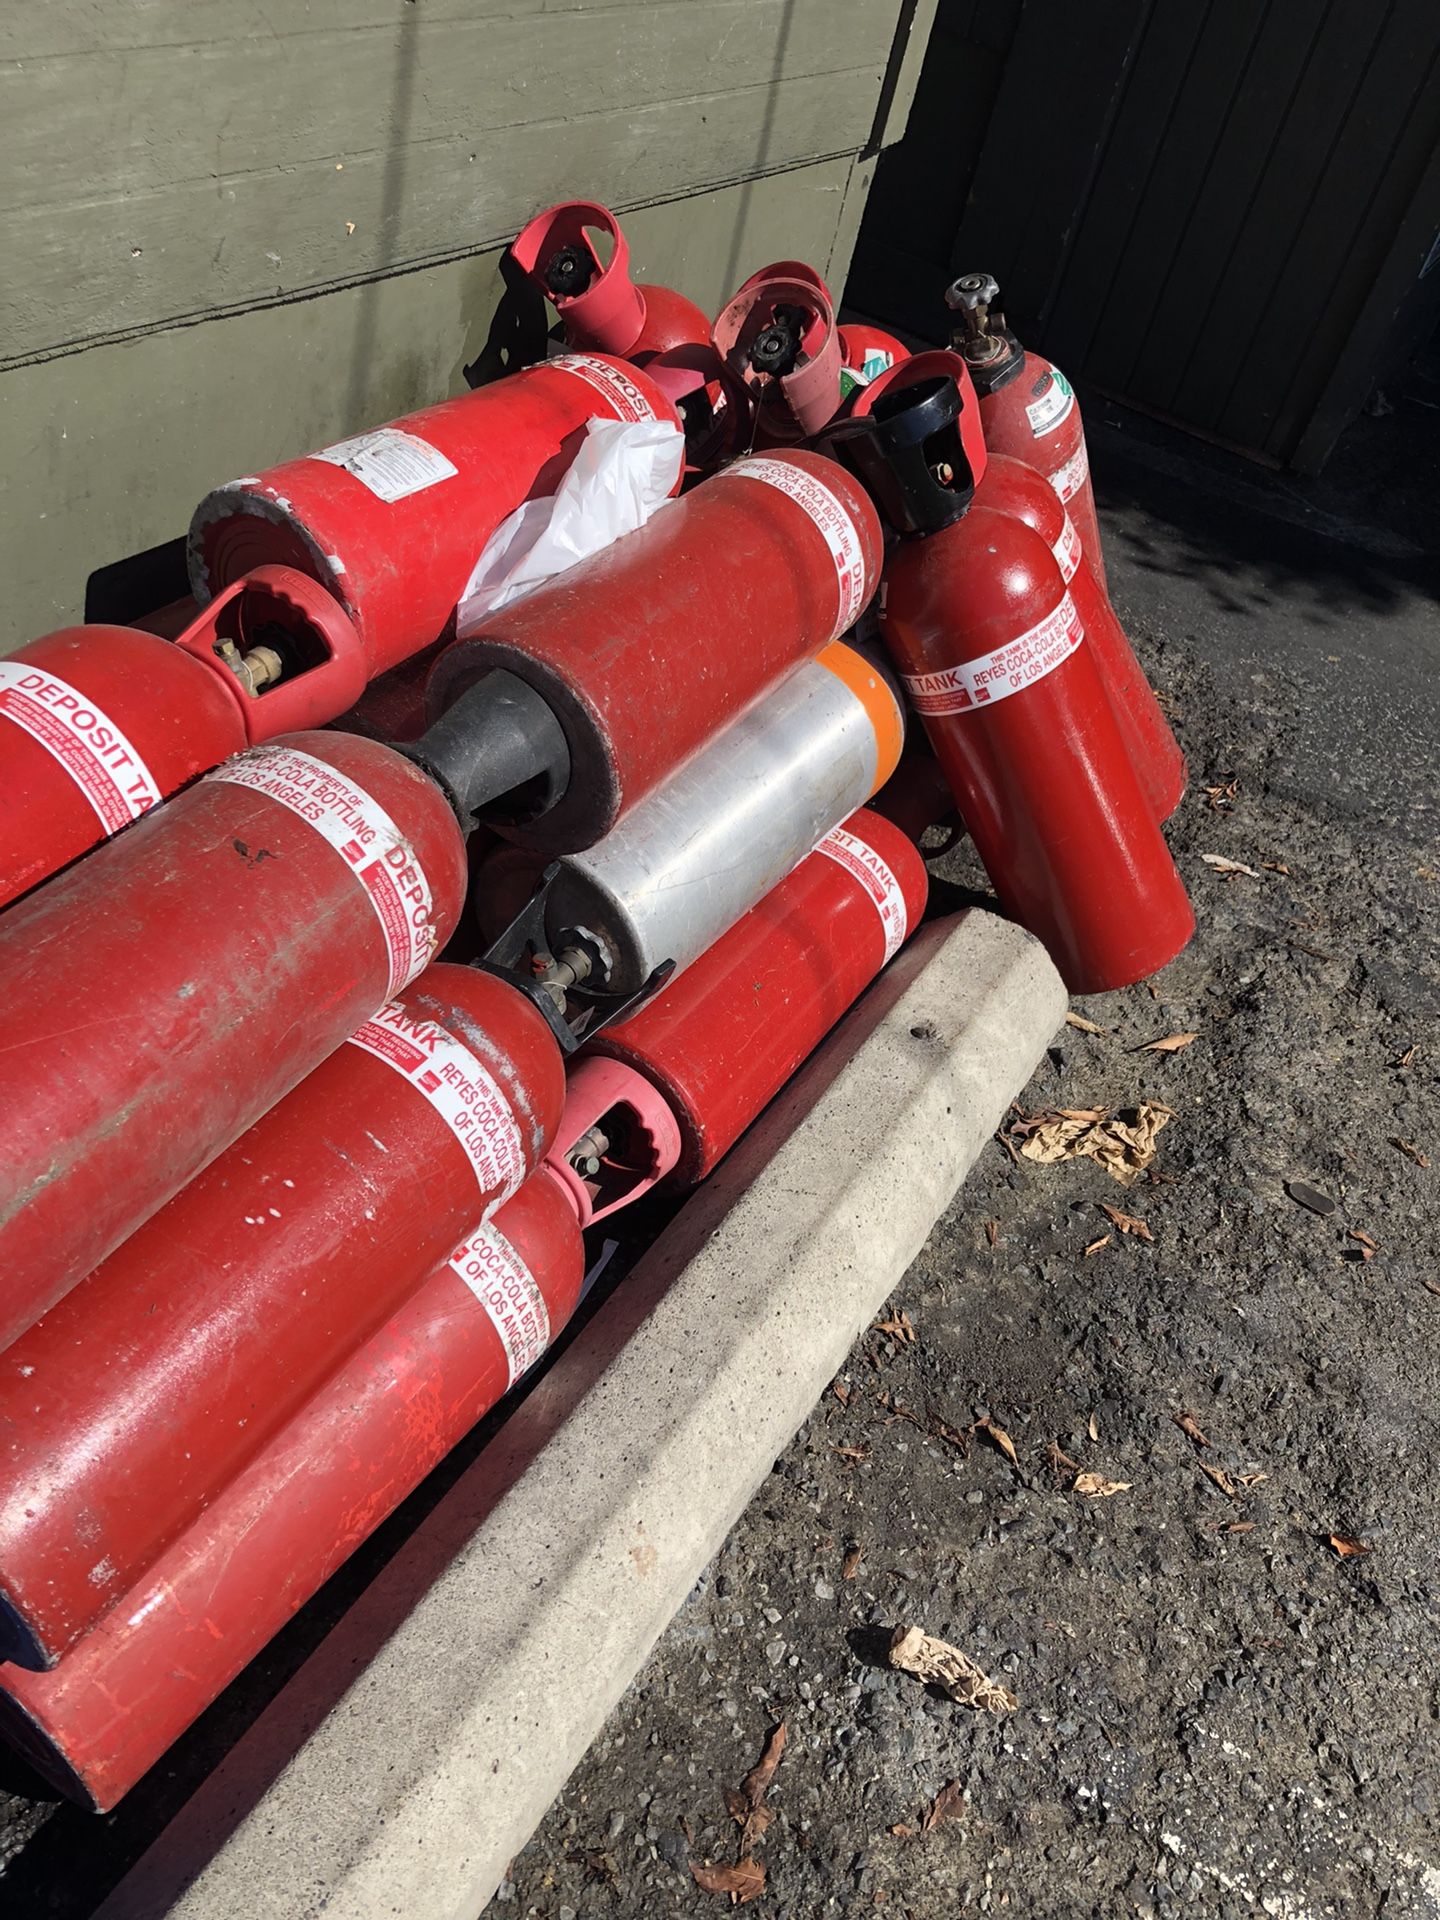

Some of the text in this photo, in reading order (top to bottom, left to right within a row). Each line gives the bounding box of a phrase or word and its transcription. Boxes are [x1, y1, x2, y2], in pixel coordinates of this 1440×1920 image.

[771, 467, 824, 508] COCA-COLA
[822, 506, 853, 557] BOTTLING
[773, 478, 795, 493] LOS
[792, 491, 831, 532] ANGELES
[973, 664, 1007, 687] REYES
[1006, 631, 1057, 672] COCA-COLA
[990, 652, 1005, 665] THIS
[1005, 643, 1023, 657] TANK
[1009, 671, 1023, 688] OF
[1023, 660, 1043, 680] LOS
[914, 670, 964, 693] TANK
[16, 673, 135, 770] DEPOSIT
[234, 768, 266, 786] LOS
[261, 778, 326, 821] ANGELES
[290, 756, 308, 768] THE
[305, 764, 352, 797] PROPERTY
[347, 790, 364, 807] OF
[311, 783, 377, 844] BOTTLING
[859, 847, 896, 892] TANK
[384, 843, 429, 964] DEPOSIT
[376, 1004, 445, 1053] TANK
[475, 1077, 492, 1098] THIS
[488, 1096, 504, 1120] TANK
[440, 1062, 511, 1174] REYES COCA-COLA
[453, 1111, 474, 1131] OF
[465, 1128, 487, 1159] LOS
[500, 1117, 509, 1128] IS
[504, 1125, 515, 1143] THE
[465, 1261, 488, 1281] OF
[482, 1281, 508, 1316] LOS
[471, 1237, 529, 1316] COCA-COLA
